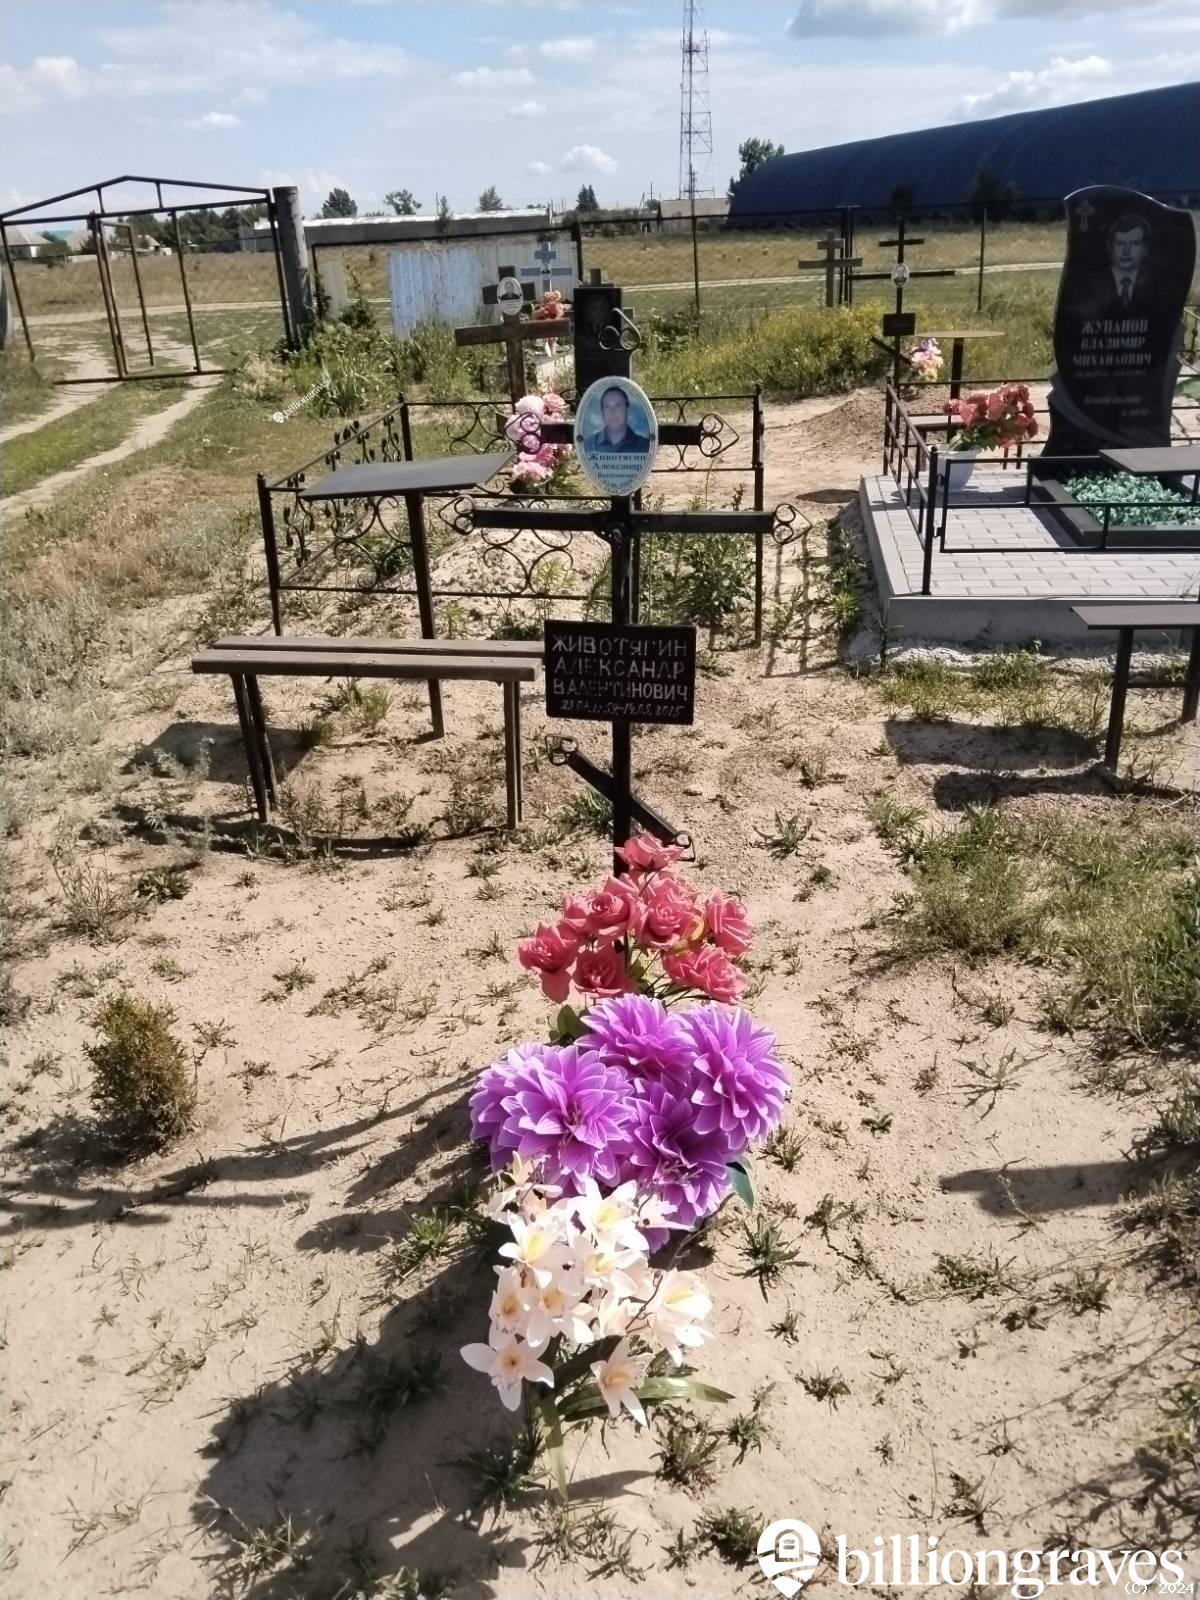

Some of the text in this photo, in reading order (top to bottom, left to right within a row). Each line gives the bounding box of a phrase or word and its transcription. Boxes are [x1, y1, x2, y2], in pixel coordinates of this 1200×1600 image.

[1080, 319, 1149, 334] ЖУПАНОВ
[1080, 337, 1146, 350] ВЛАДИМИР
[552, 635, 687, 657] ЖИВОТЯГИН
[554, 656, 685, 680] АЛЕКСАНДР
[553, 678, 688, 702] ВАЛЕНТИНОВИЧ
